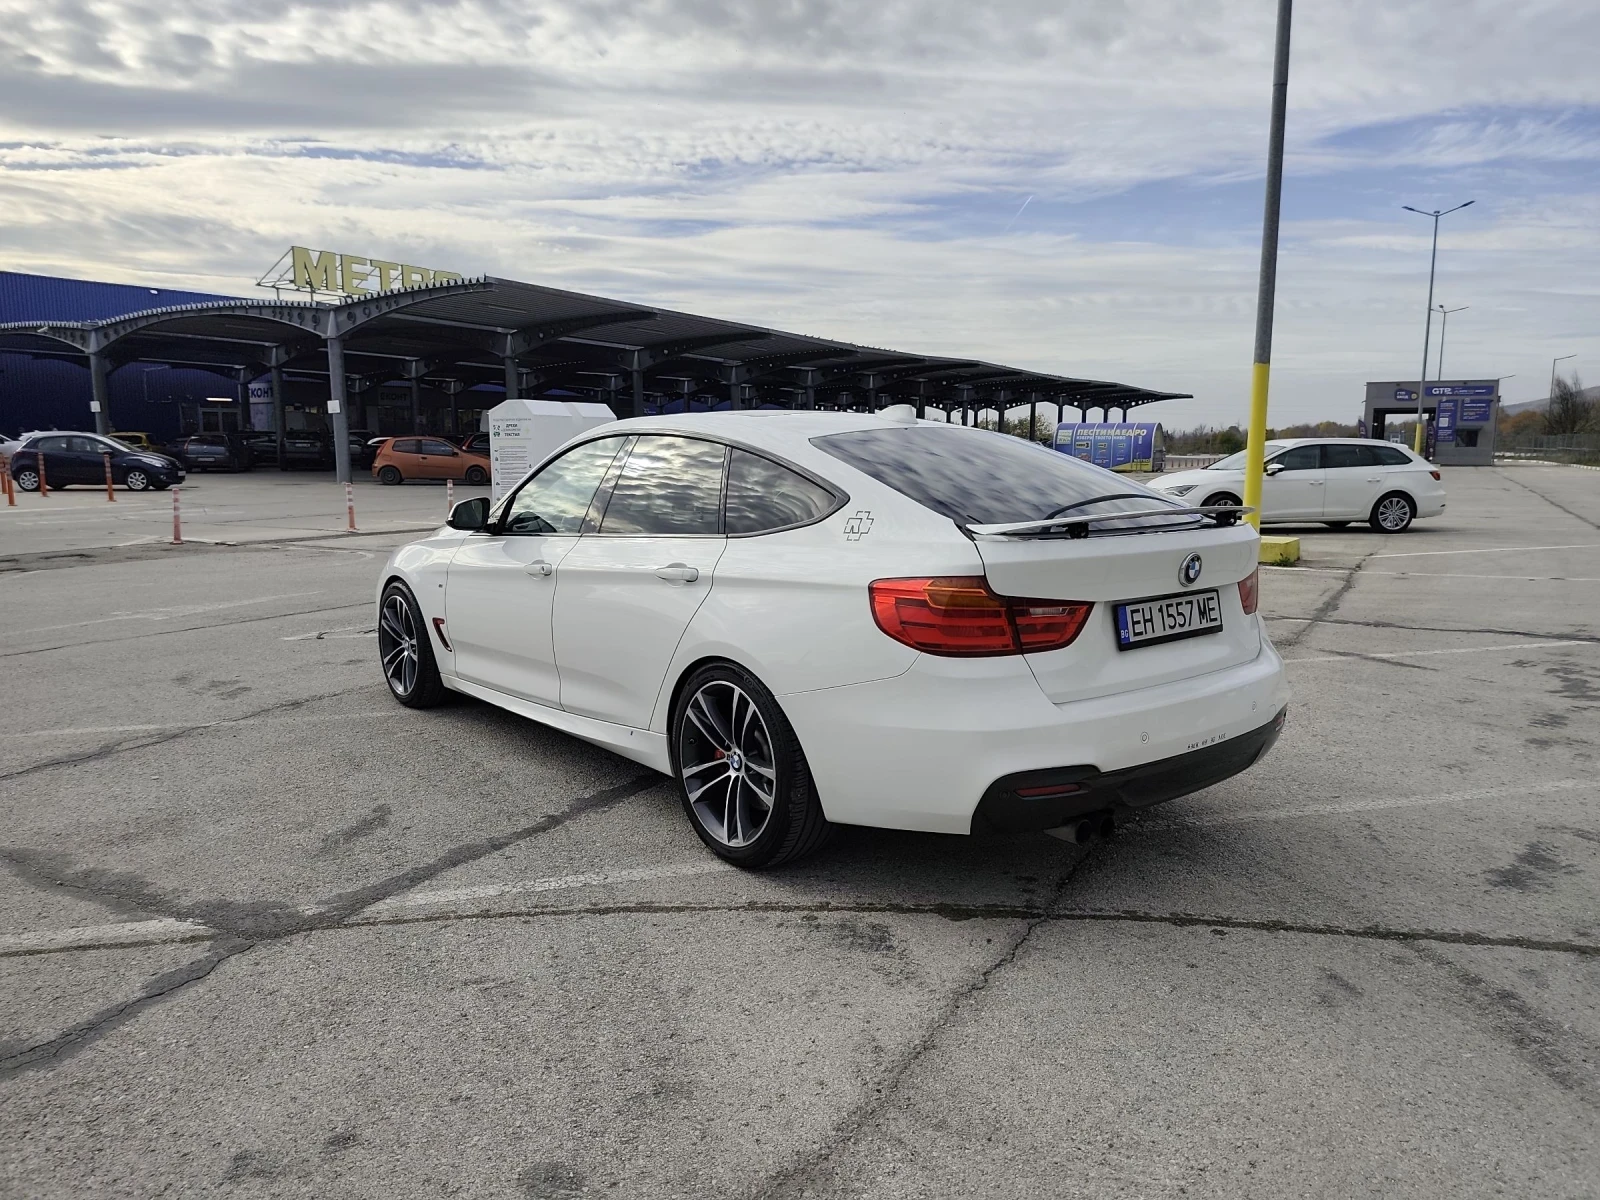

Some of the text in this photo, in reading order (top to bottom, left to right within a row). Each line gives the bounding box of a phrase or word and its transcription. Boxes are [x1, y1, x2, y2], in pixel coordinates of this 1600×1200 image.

[1130, 596, 1218, 637] EH 1557 ME
[1120, 629, 1129, 639] BG
